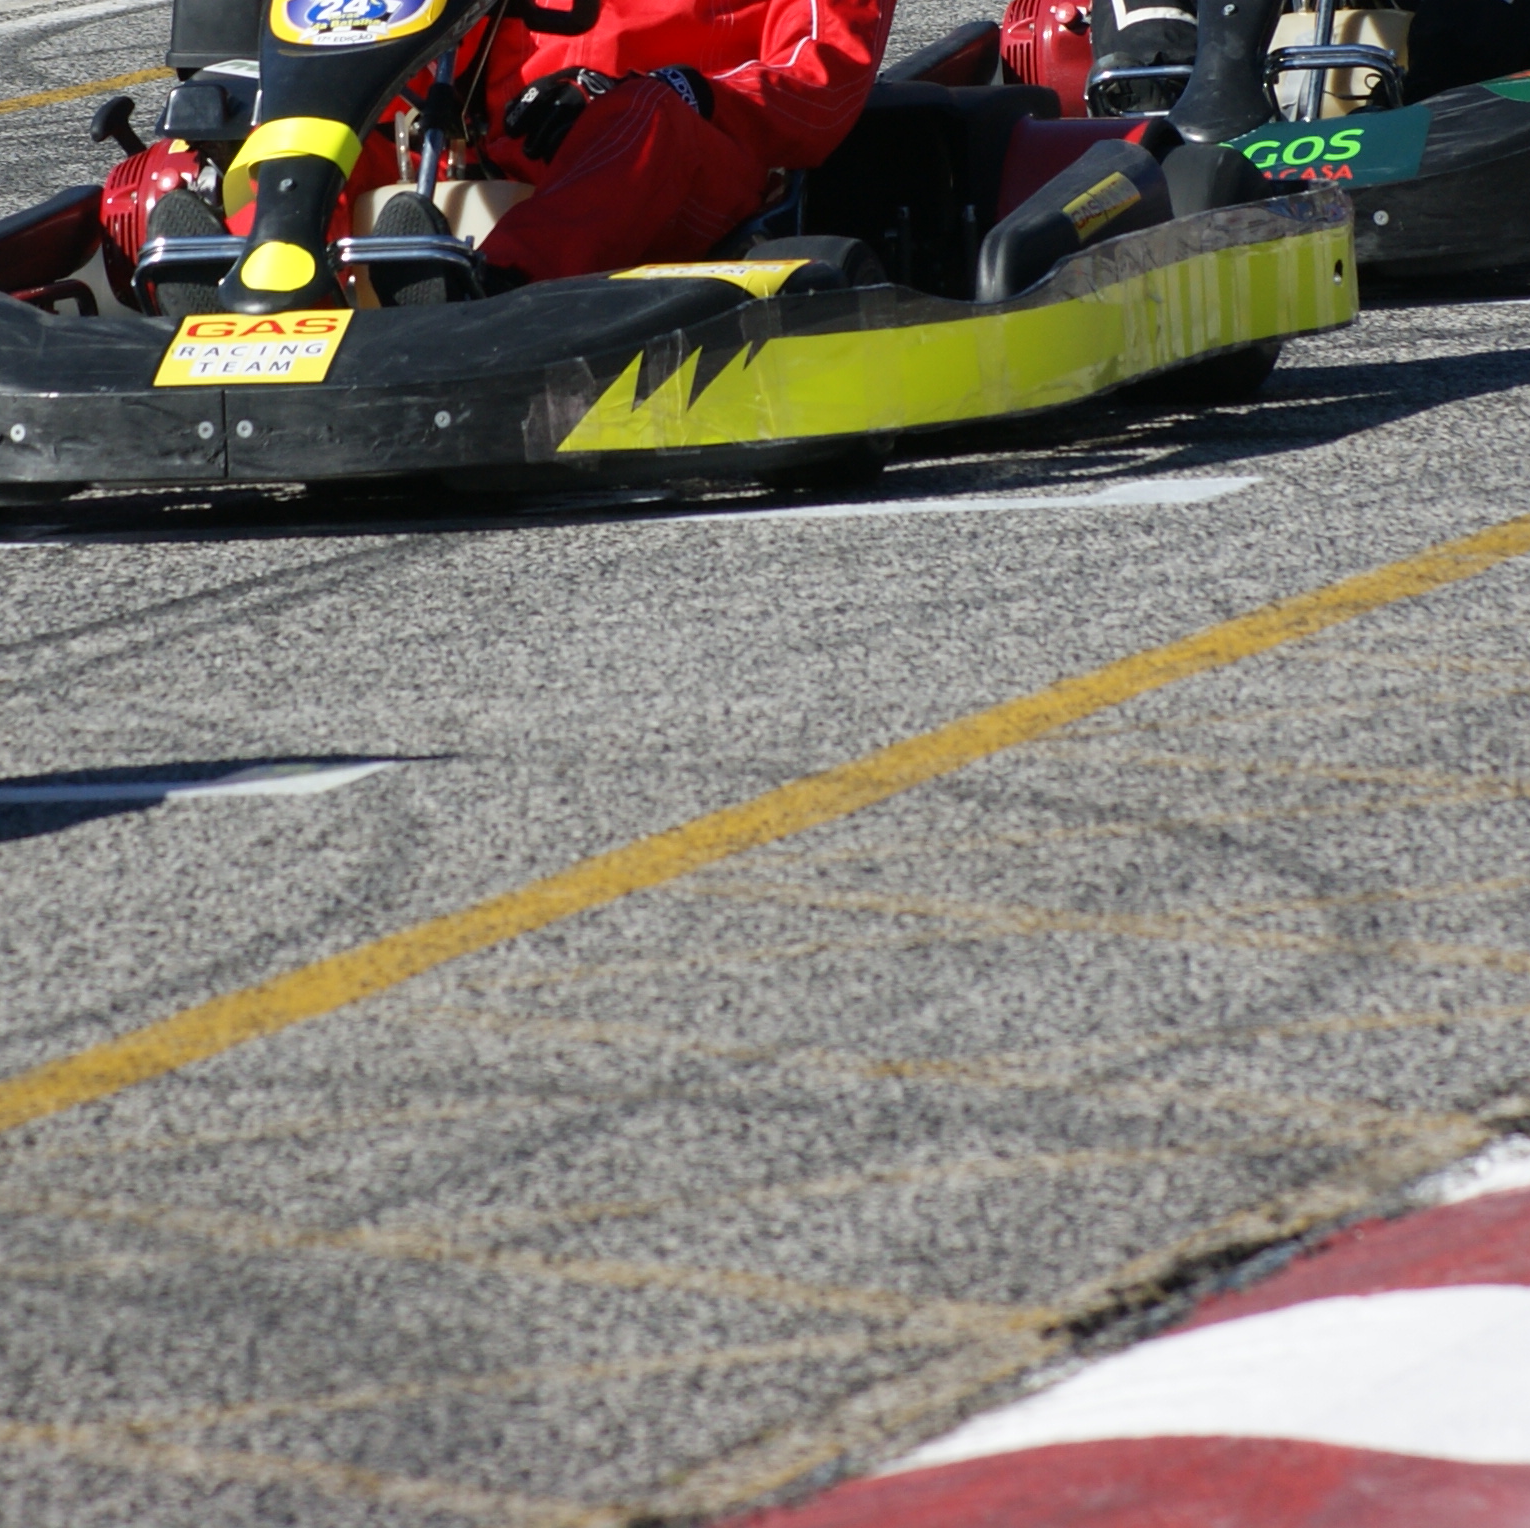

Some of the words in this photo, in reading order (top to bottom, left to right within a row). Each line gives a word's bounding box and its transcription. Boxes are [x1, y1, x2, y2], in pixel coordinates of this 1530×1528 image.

[1217, 128, 1365, 169] GOS
[185, 317, 339, 338] GAS
[178, 341, 323, 357] RACING
[199, 360, 292, 373] TEAM
